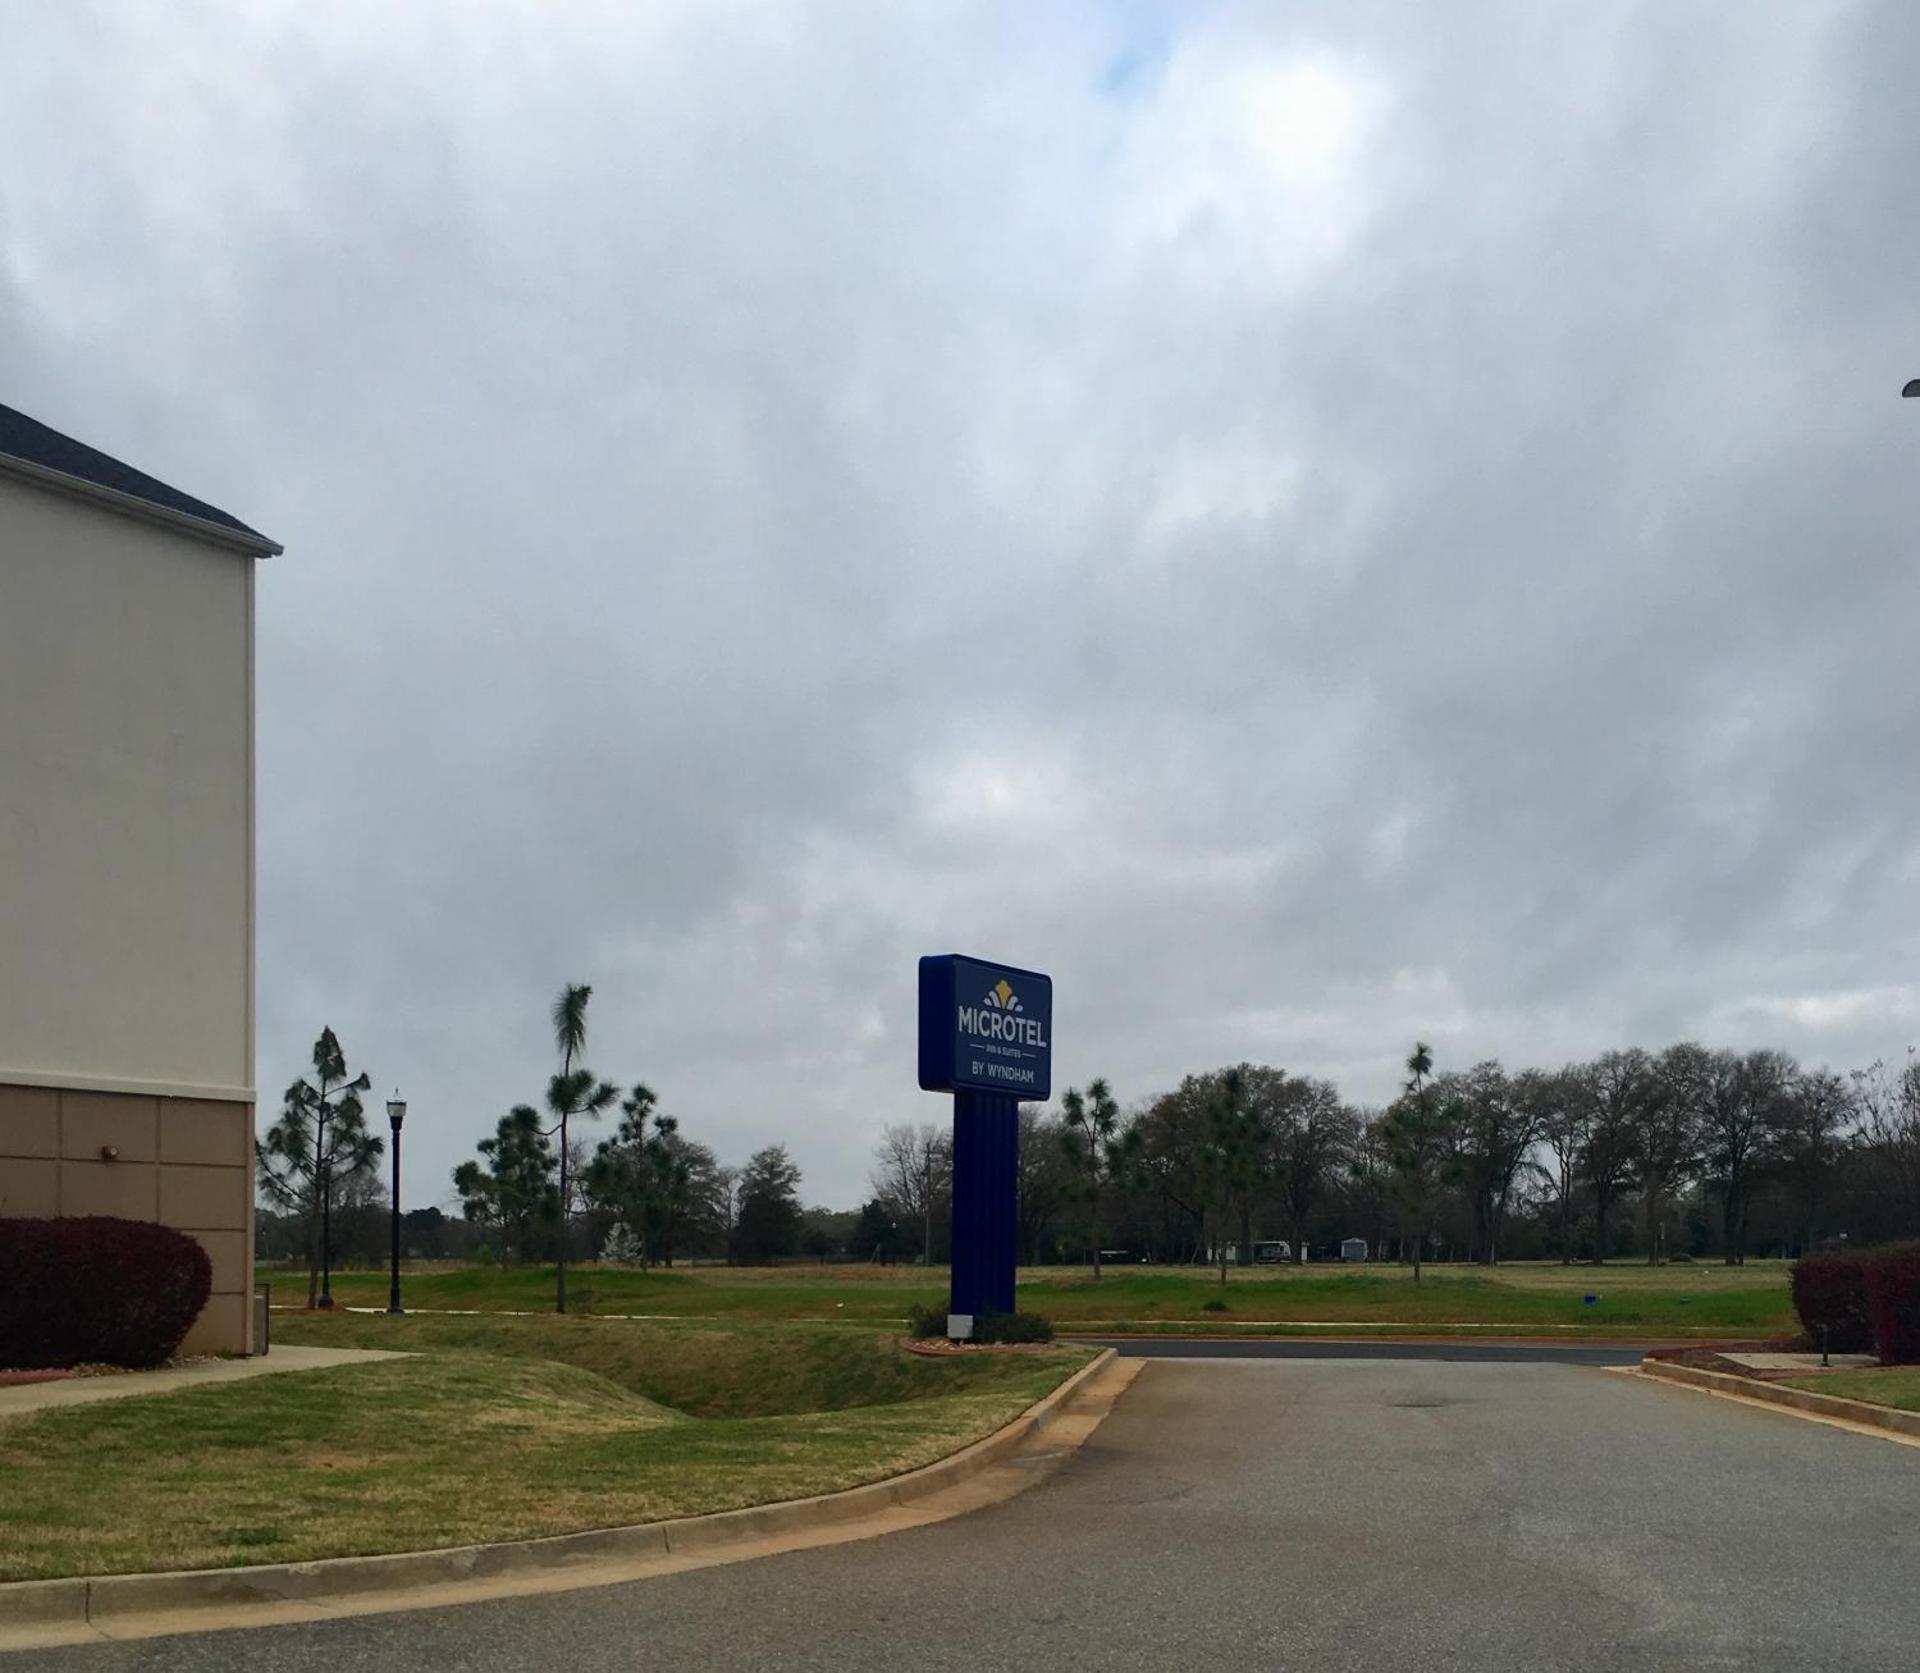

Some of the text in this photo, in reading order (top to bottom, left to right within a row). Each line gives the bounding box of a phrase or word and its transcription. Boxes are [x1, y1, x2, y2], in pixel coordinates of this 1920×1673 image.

[958, 1005, 1047, 1047] MICROTEL
[972, 1061, 1034, 1083] BY WYNDHAM
